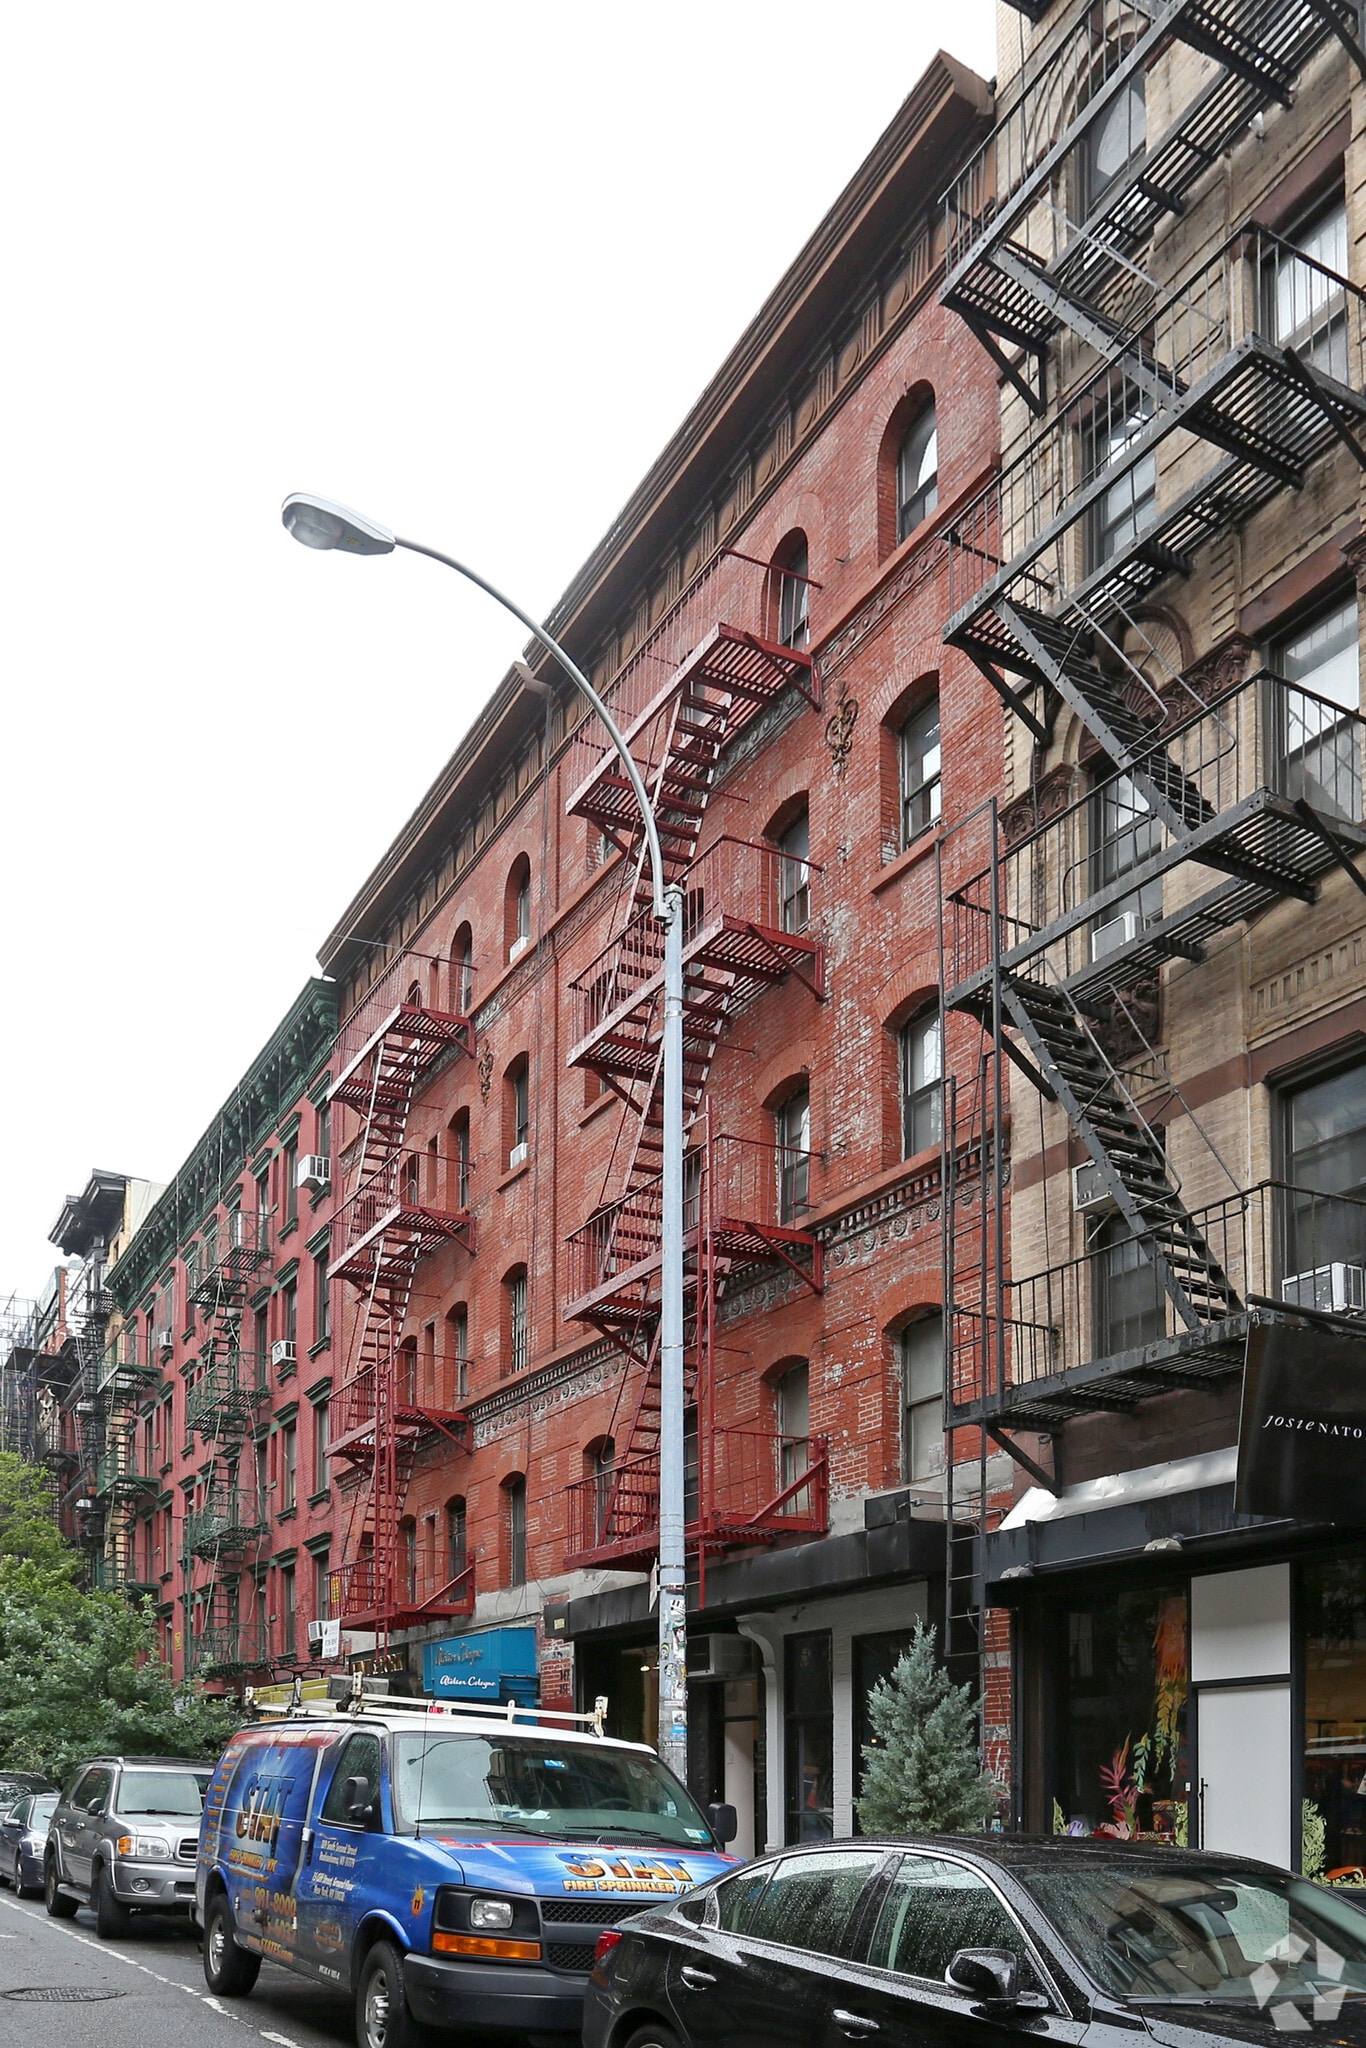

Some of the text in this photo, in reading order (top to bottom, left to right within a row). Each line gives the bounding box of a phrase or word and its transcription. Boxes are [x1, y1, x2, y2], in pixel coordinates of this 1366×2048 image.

[440, 1675, 497, 1690] Atelier Cologne
[555, 1853, 693, 1881] STAT
[562, 1880, 596, 1892] FIRE
[598, 1881, 678, 1894] SPRINKLER
